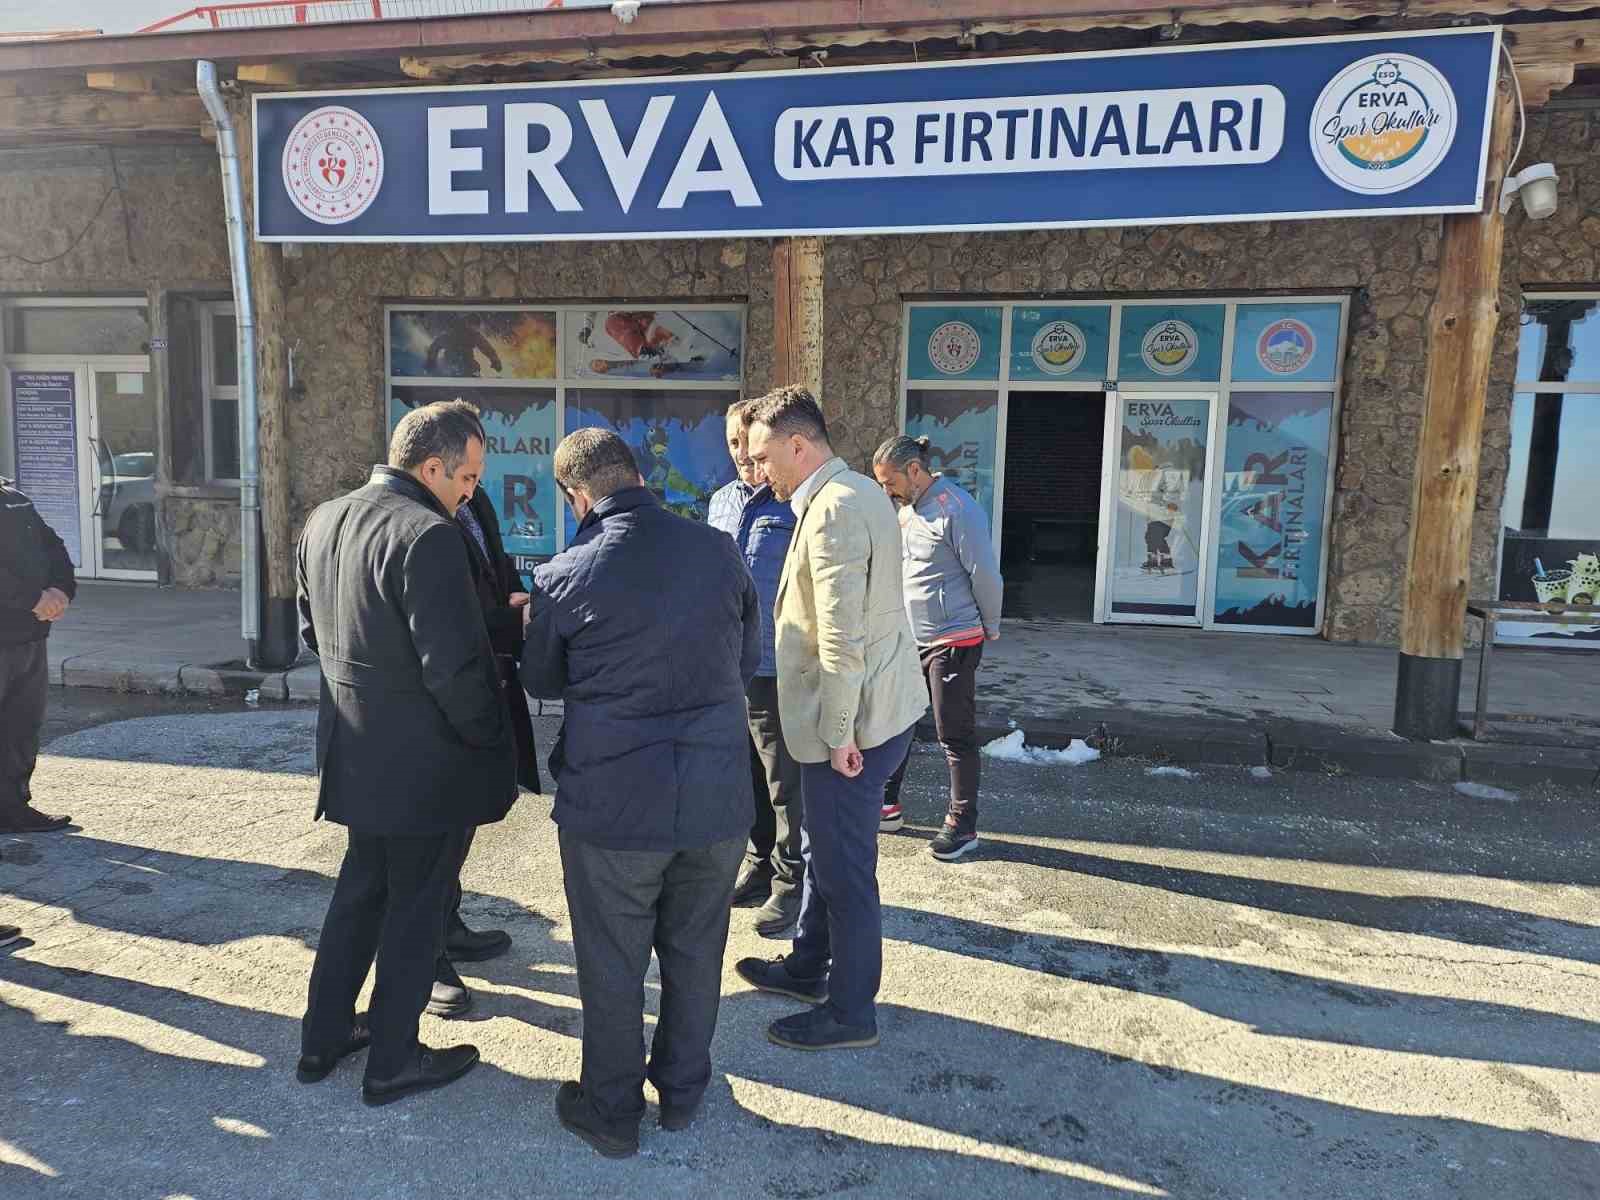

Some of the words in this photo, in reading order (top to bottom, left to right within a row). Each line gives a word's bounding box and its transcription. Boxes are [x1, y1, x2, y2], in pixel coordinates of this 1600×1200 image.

[1358, 92, 1409, 108] ERVA
[1322, 115, 1367, 145] Spor
[426, 90, 764, 216] ERVA
[793, 115, 897, 170] KAR
[914, 97, 1264, 164] FIRTINALARI
[1127, 403, 1175, 417] ERVA
[486, 436, 551, 455] RLARI
[1235, 449, 1289, 580] KAR
